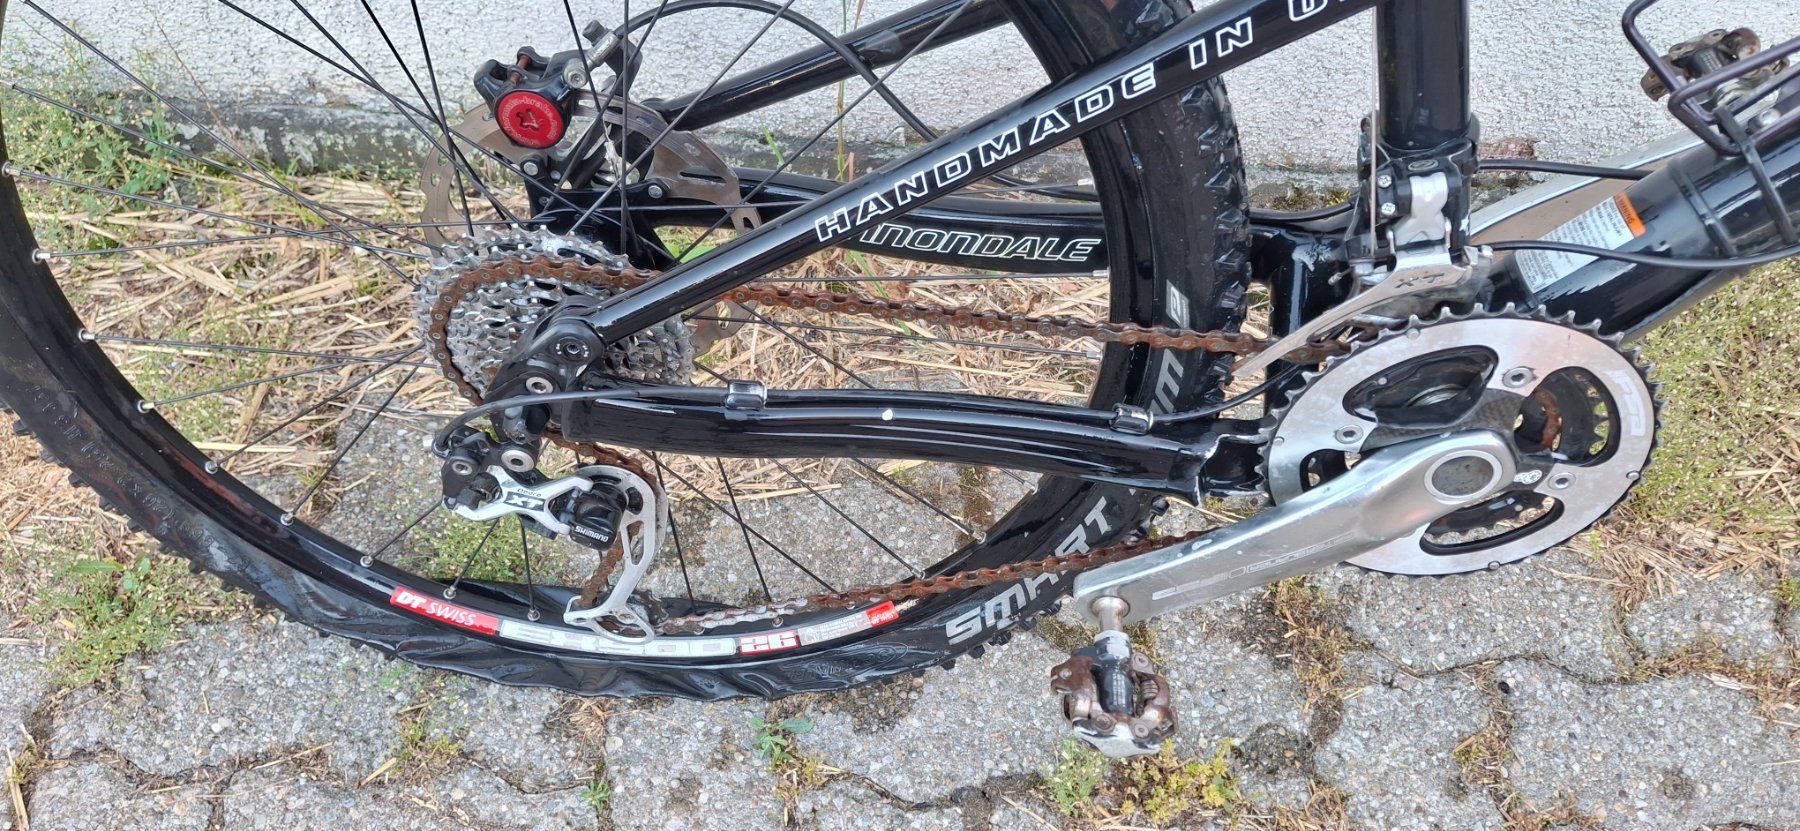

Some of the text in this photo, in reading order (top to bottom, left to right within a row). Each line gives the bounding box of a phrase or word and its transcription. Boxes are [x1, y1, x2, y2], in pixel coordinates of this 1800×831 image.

[815, 17, 1253, 242] HANDMADE IN
[1395, 273, 1445, 288] XT
[506, 494, 545, 510] XT
[517, 487, 542, 498] Deore
[574, 525, 609, 542] SHIMANO
[945, 496, 1112, 645] SMART
[396, 591, 476, 626] DT SWISS
[741, 631, 798, 654] 26
